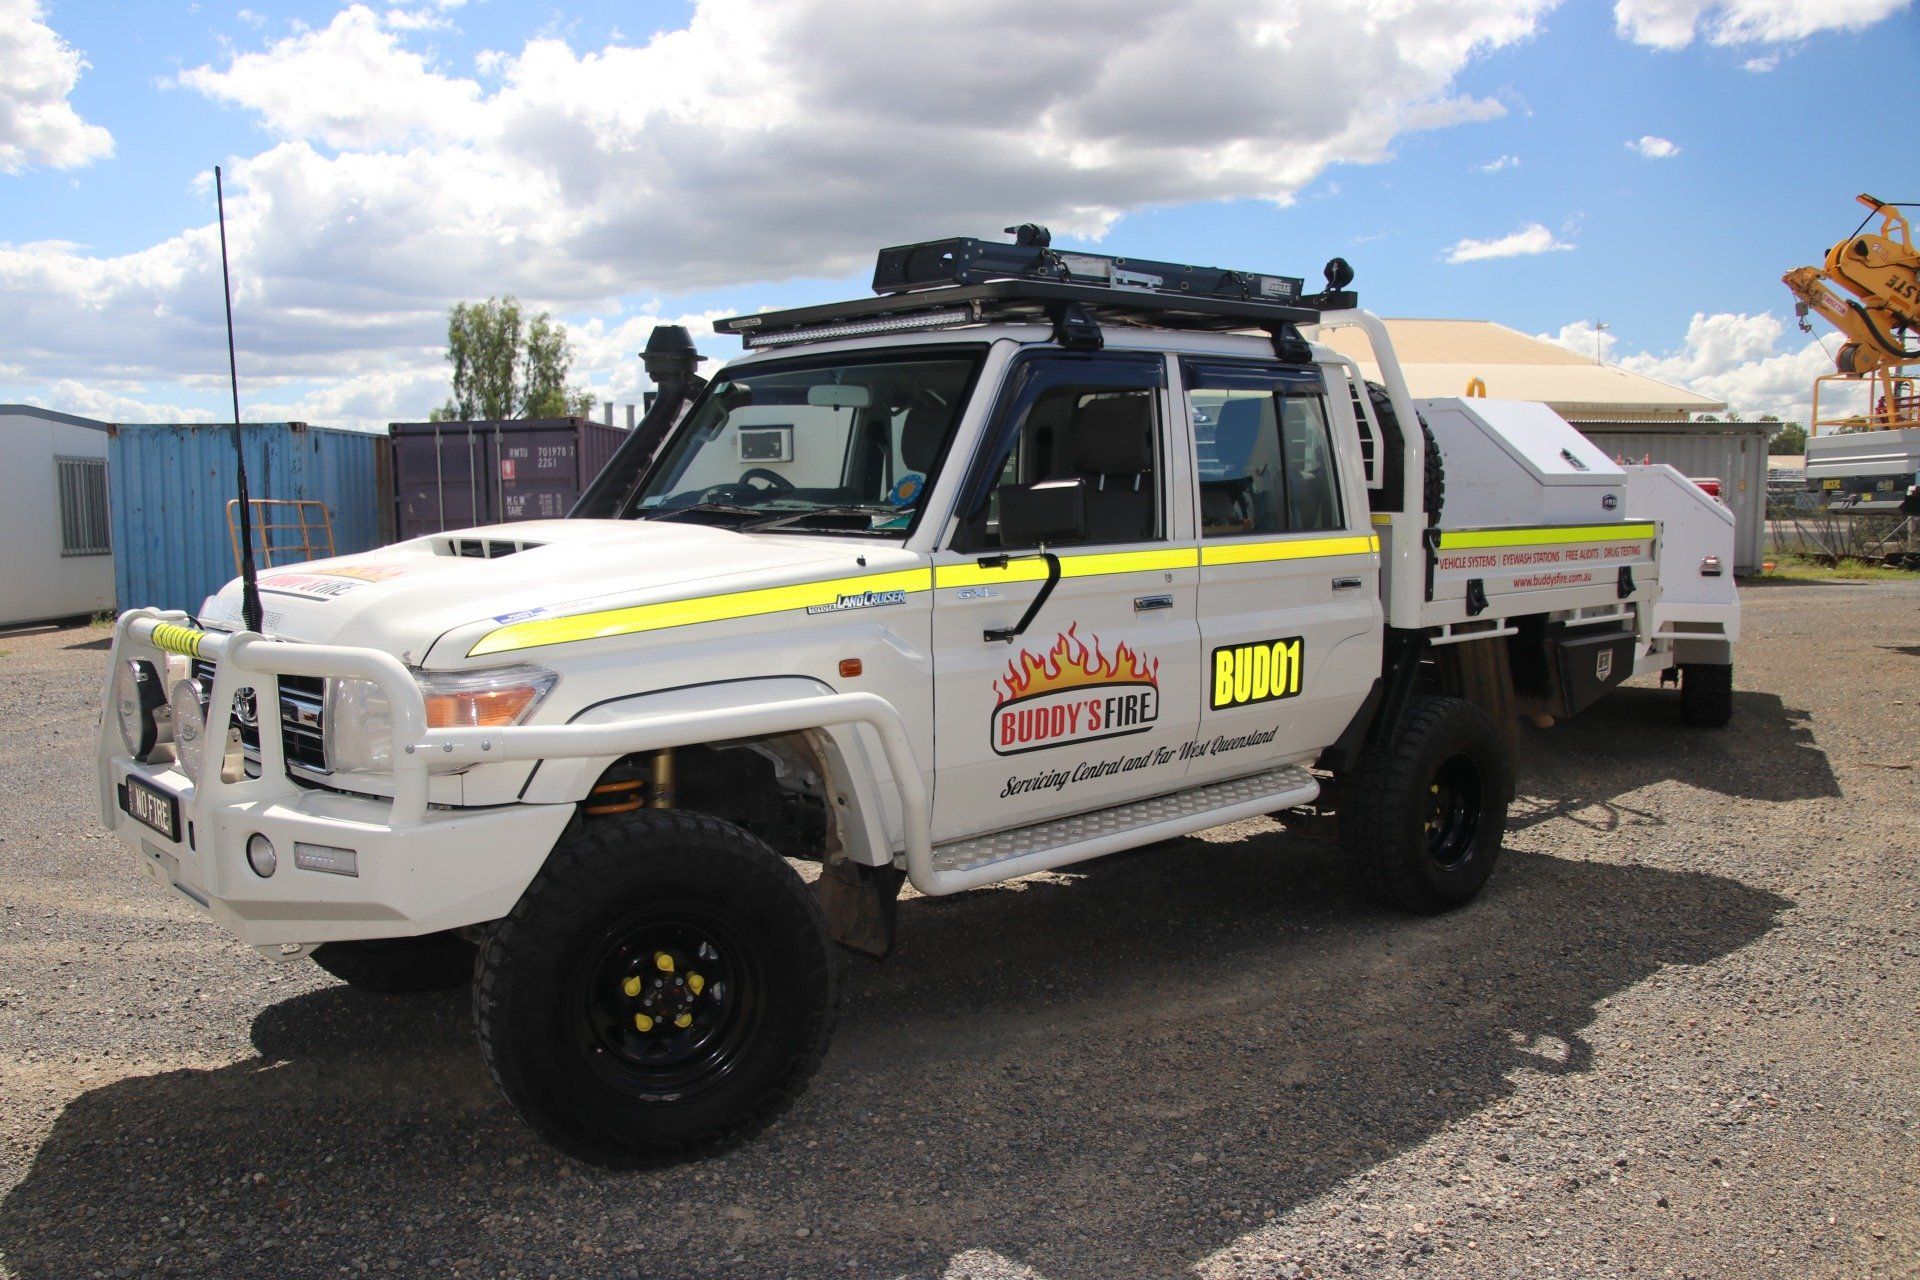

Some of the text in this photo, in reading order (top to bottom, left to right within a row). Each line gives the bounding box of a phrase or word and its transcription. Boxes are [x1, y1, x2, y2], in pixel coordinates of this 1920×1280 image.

[509, 447, 528, 458] RWTU
[538, 446, 566, 457] 701978
[1439, 545, 1641, 570] VEHICLE SYSTEMS EYEWASH STATIONS FREE AUDITS DRUG TESTING
[1513, 572, 1592, 588] www.buddysfire.com.au
[957, 588, 998, 599] GXL
[809, 605, 835, 613] TOYOTA
[1214, 640, 1300, 707] BUD01
[1001, 692, 1151, 746] BUDDY'S FIRE
[1000, 726, 1279, 798] Servicing Central and Far West Queensland
[148, 793, 169, 831] FIRE
